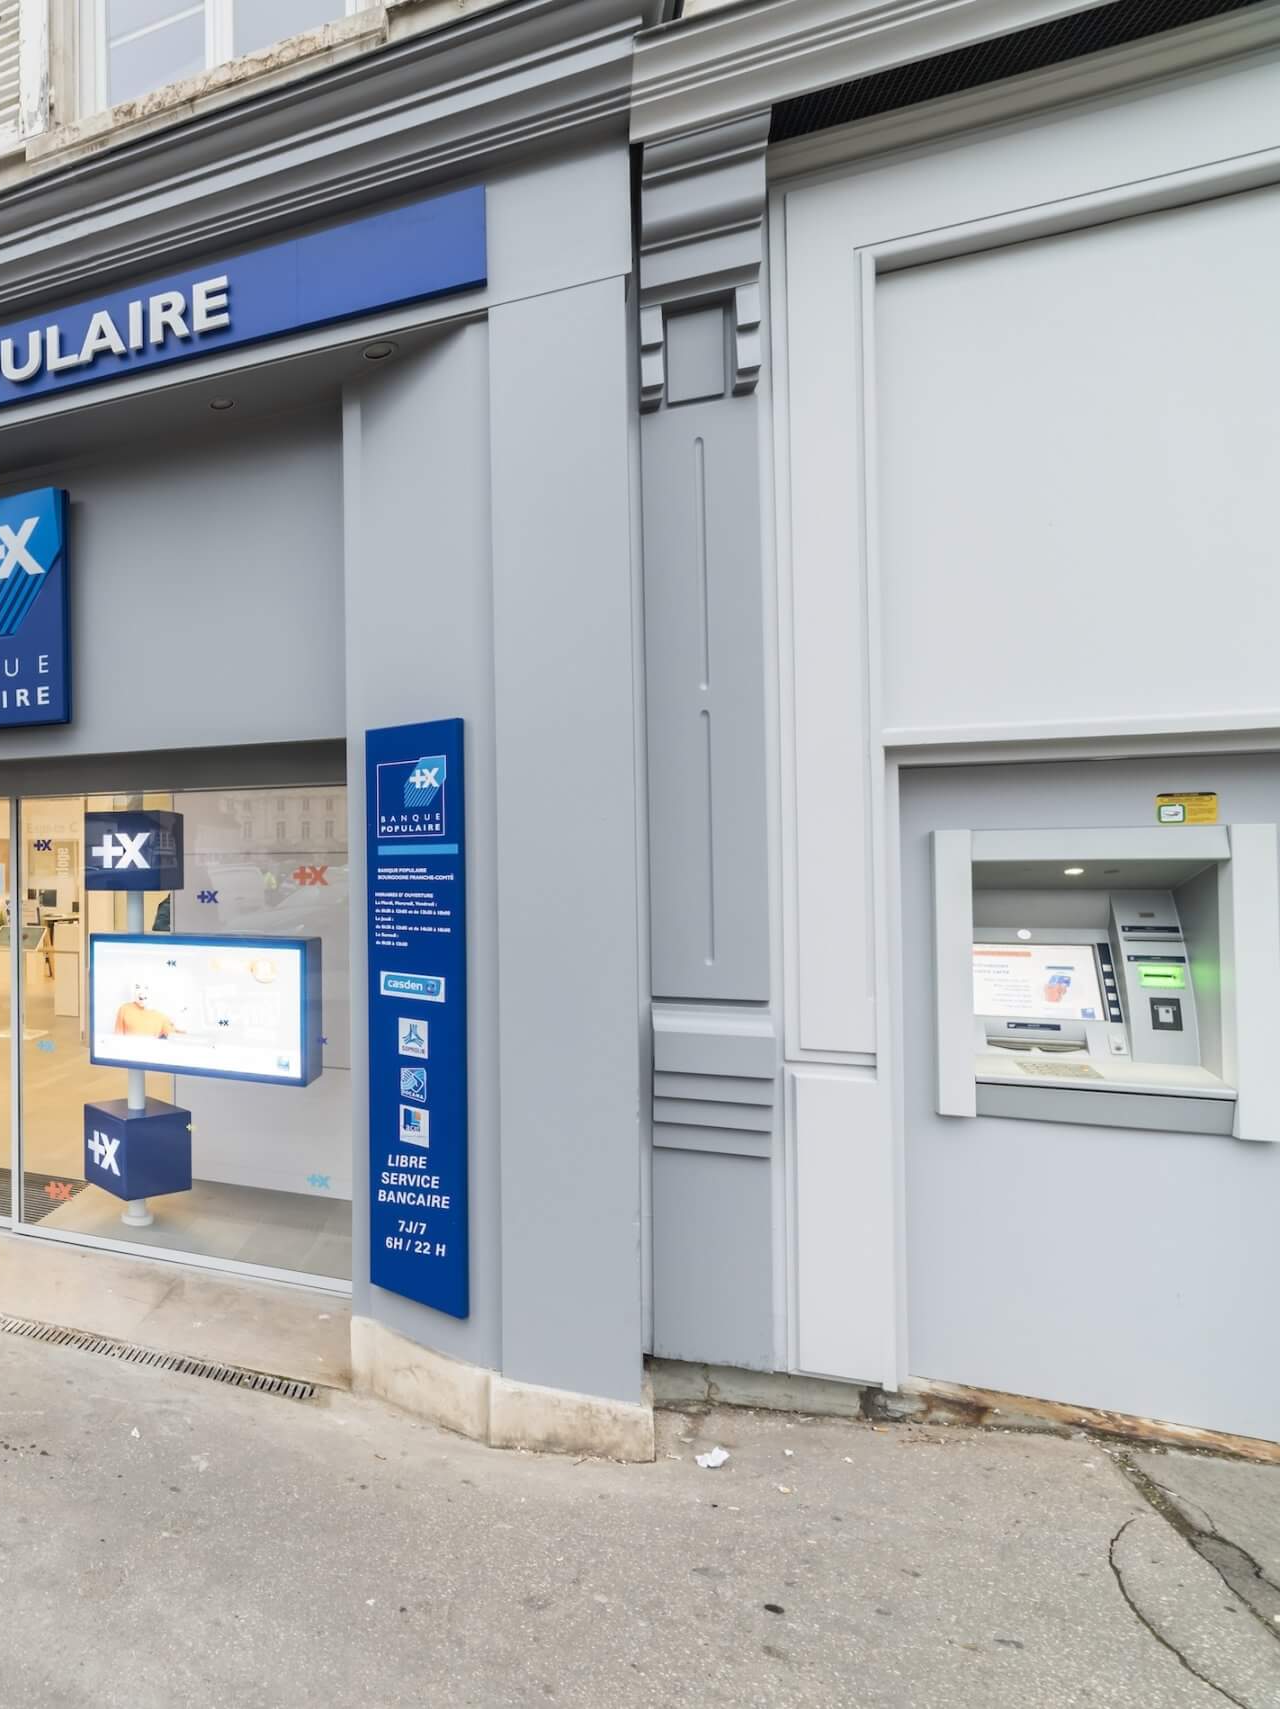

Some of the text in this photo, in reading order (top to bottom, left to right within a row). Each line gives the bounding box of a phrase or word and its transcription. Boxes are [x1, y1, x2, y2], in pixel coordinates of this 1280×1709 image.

[380, 813, 441, 823] BANQUE
[380, 823, 441, 833] POPULAIRE
[387, 979, 423, 992] casden
[387, 1154, 427, 1169] LIBRE
[381, 1172, 440, 1189] SERVICE
[378, 1189, 450, 1209] BANCAIRE
[397, 1220, 427, 1235] 7J/7
[385, 1236, 403, 1251] 6H
[414, 1240, 431, 1255] 22
[435, 1244, 446, 1257] H
